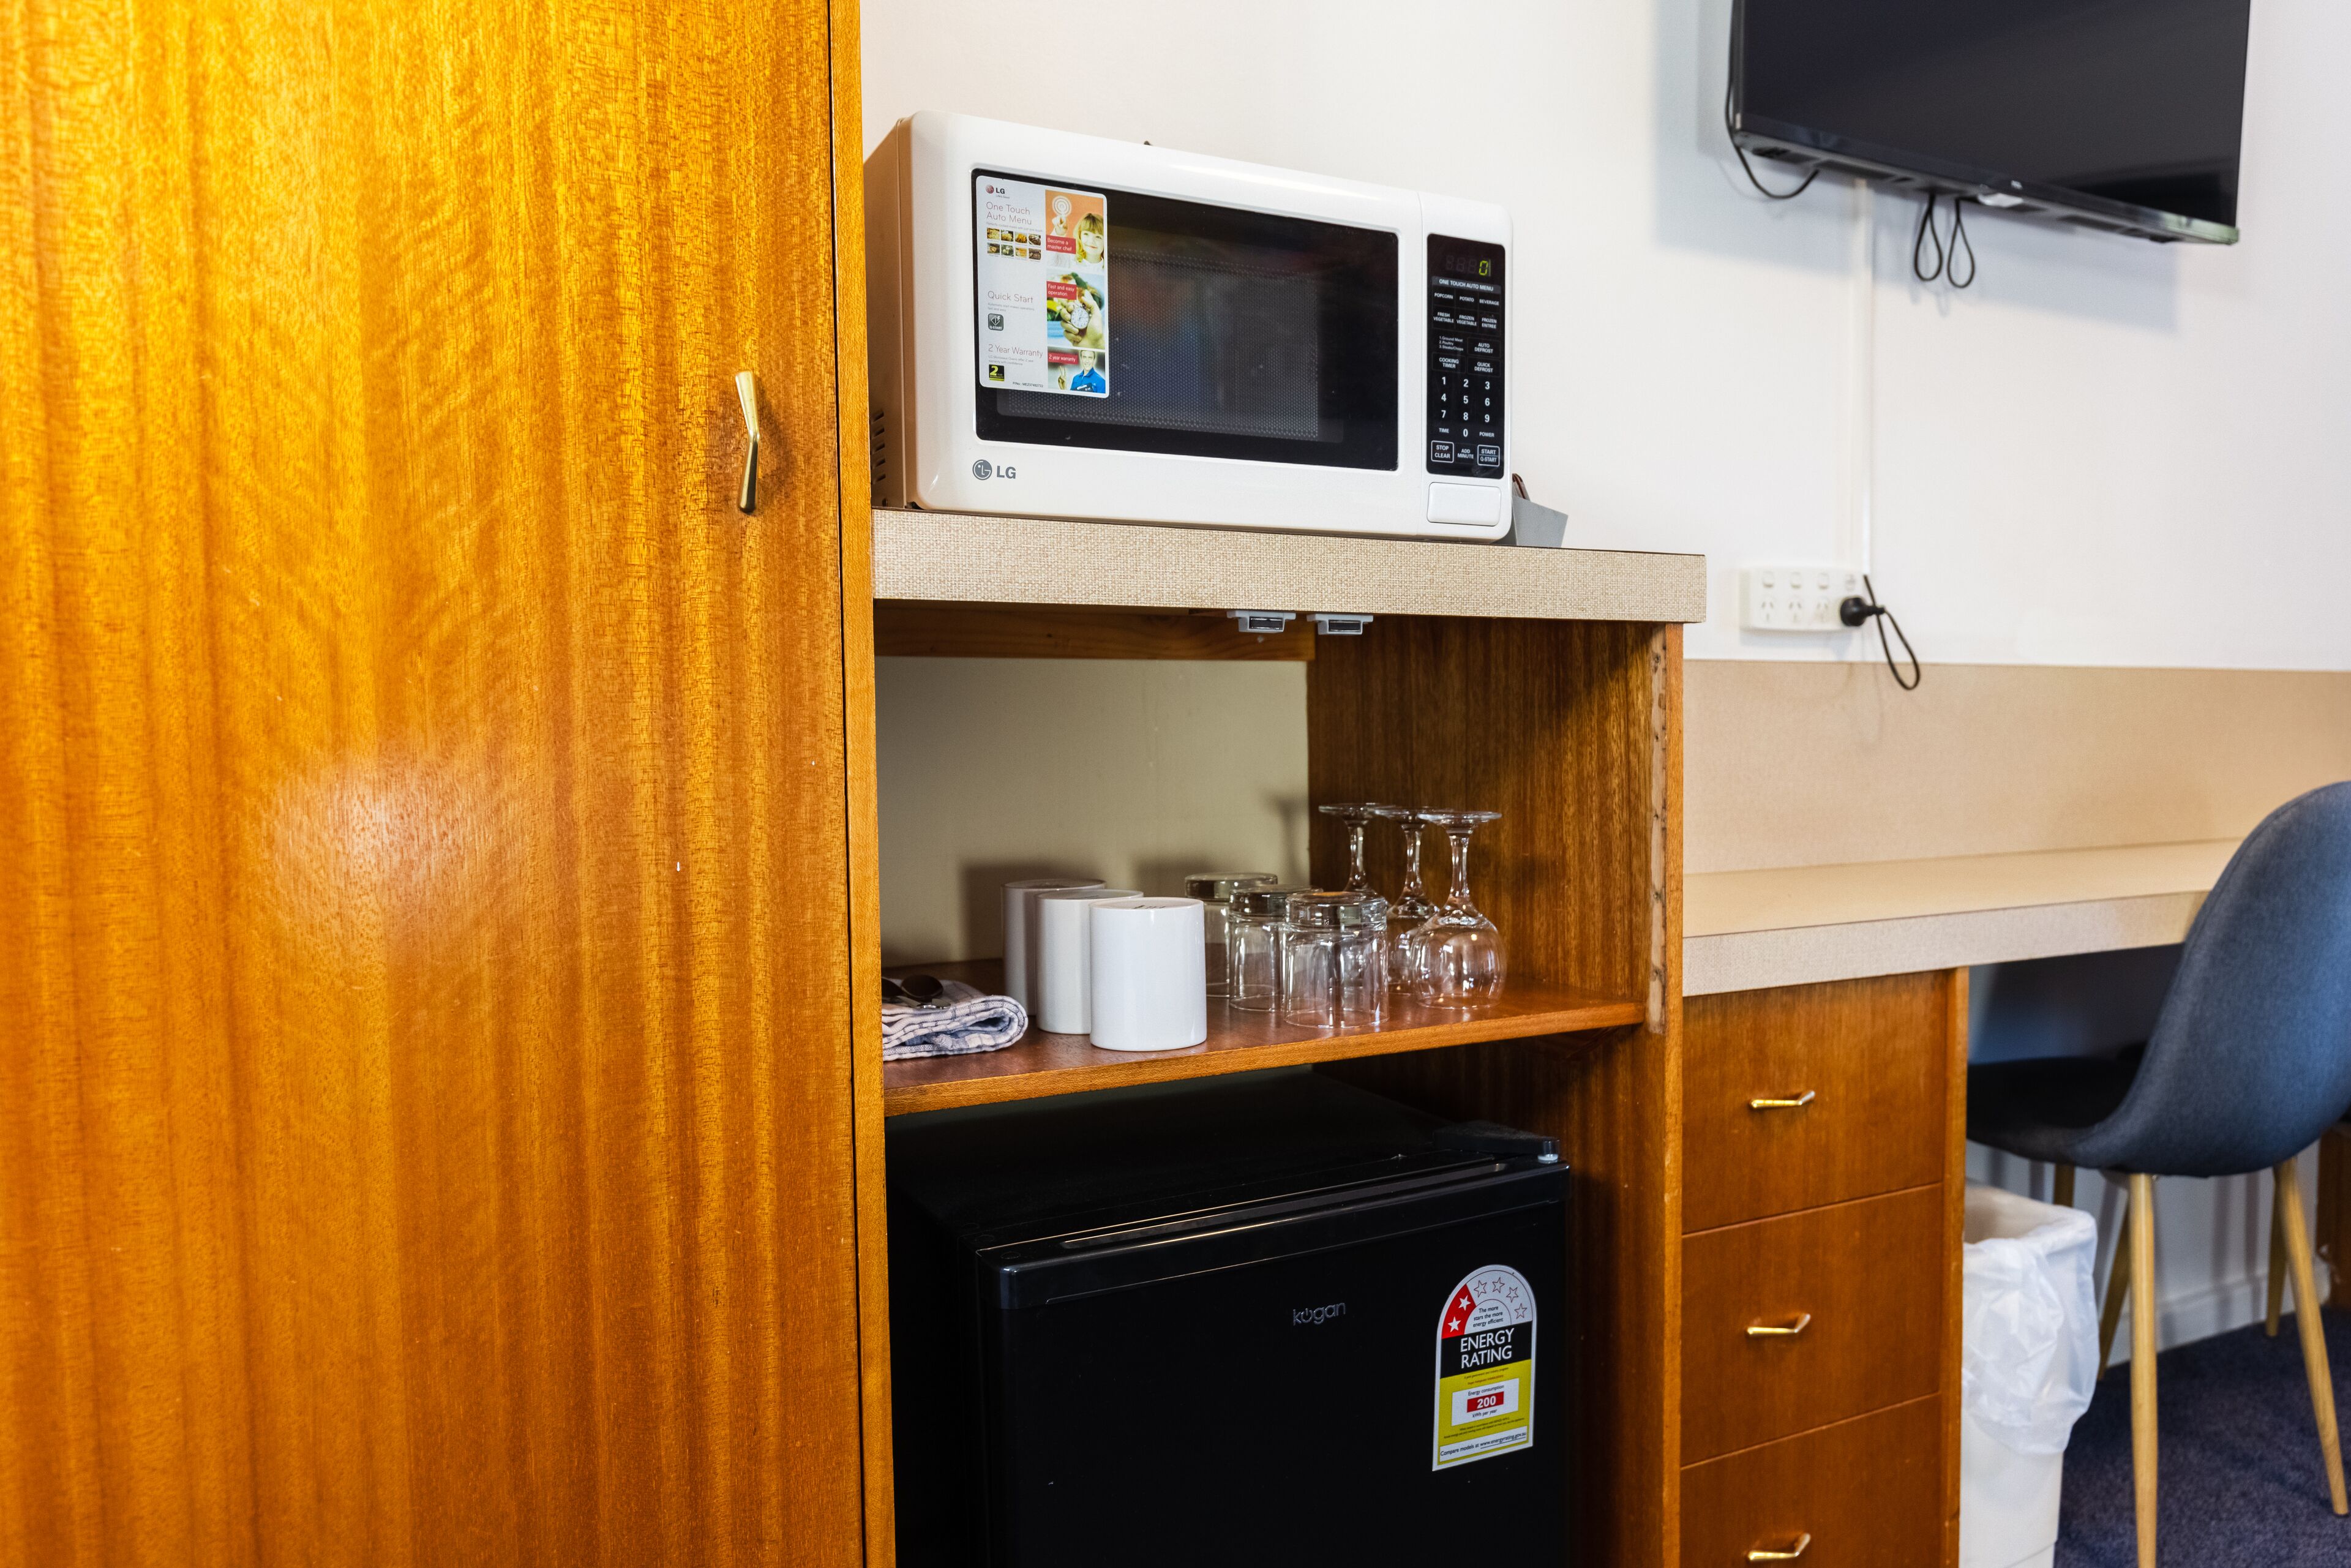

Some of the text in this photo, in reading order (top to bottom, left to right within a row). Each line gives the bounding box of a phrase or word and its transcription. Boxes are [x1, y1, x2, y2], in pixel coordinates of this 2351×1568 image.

[986, 201, 1030, 215] One Touch
[986, 211, 1032, 225] Auto Menu
[988, 291, 1033, 303] Quick Start
[995, 345, 1010, 353] Year
[1011, 347, 1043, 358] Warranty
[989, 366, 999, 376] 2
[1441, 393, 1446, 402] 4
[1463, 396, 1468, 404] 5
[997, 465, 1016, 479] LG
[1293, 1302, 1346, 1326] kogan
[1460, 1328, 1514, 1352] ENERGY
[1461, 1345, 1512, 1368] RATING
[1481, 1385, 1504, 1394] consumption
[1477, 1396, 1496, 1409] 200
[1441, 1448, 1459, 1457] Compare
[1480, 1433, 1526, 1447] www.energyrating.gov.au
